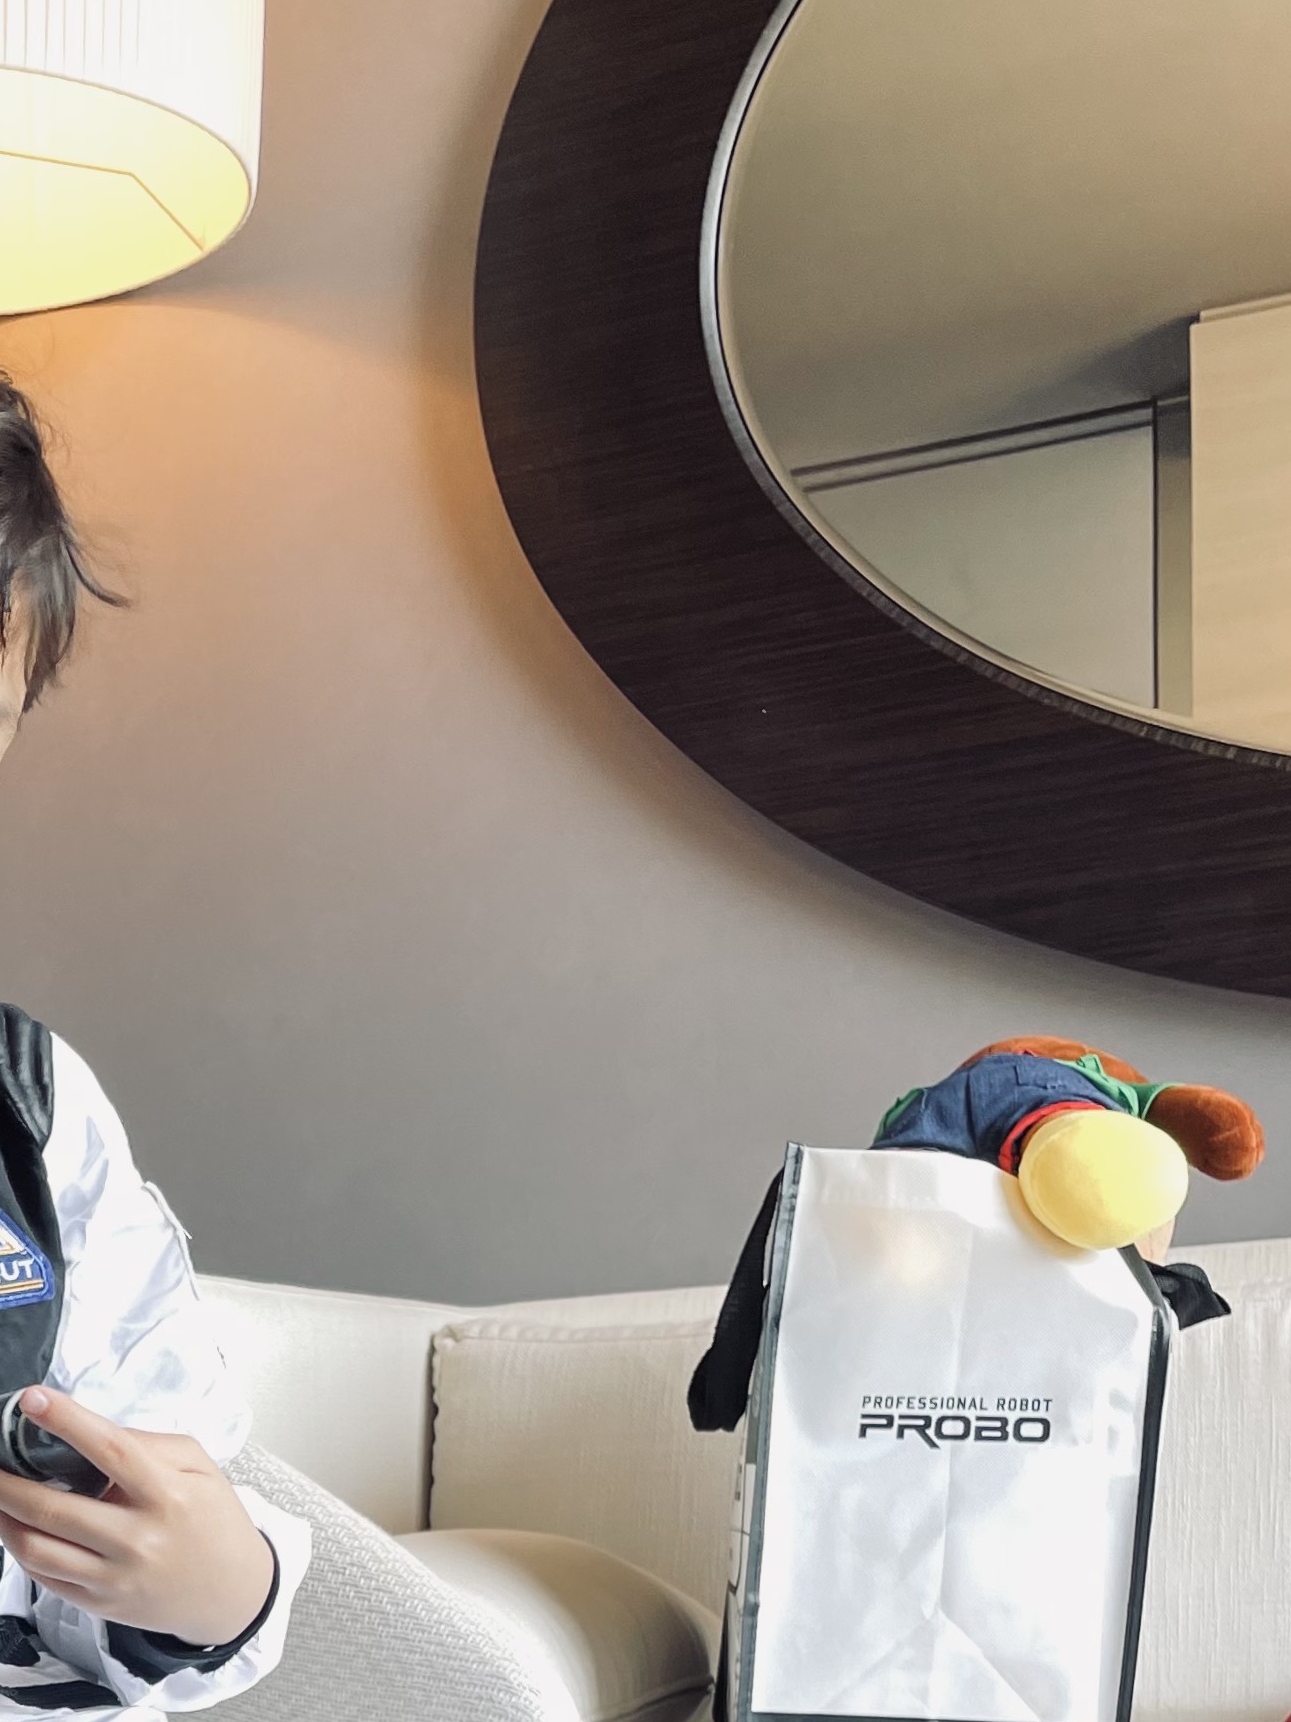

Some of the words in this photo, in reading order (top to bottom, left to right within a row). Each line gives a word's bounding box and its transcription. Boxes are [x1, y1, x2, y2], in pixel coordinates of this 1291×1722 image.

[861, 1395, 988, 1411] PROFESSIONAL
[996, 1397, 1053, 1412] ROBOT
[858, 1413, 1051, 1450] PROBO
